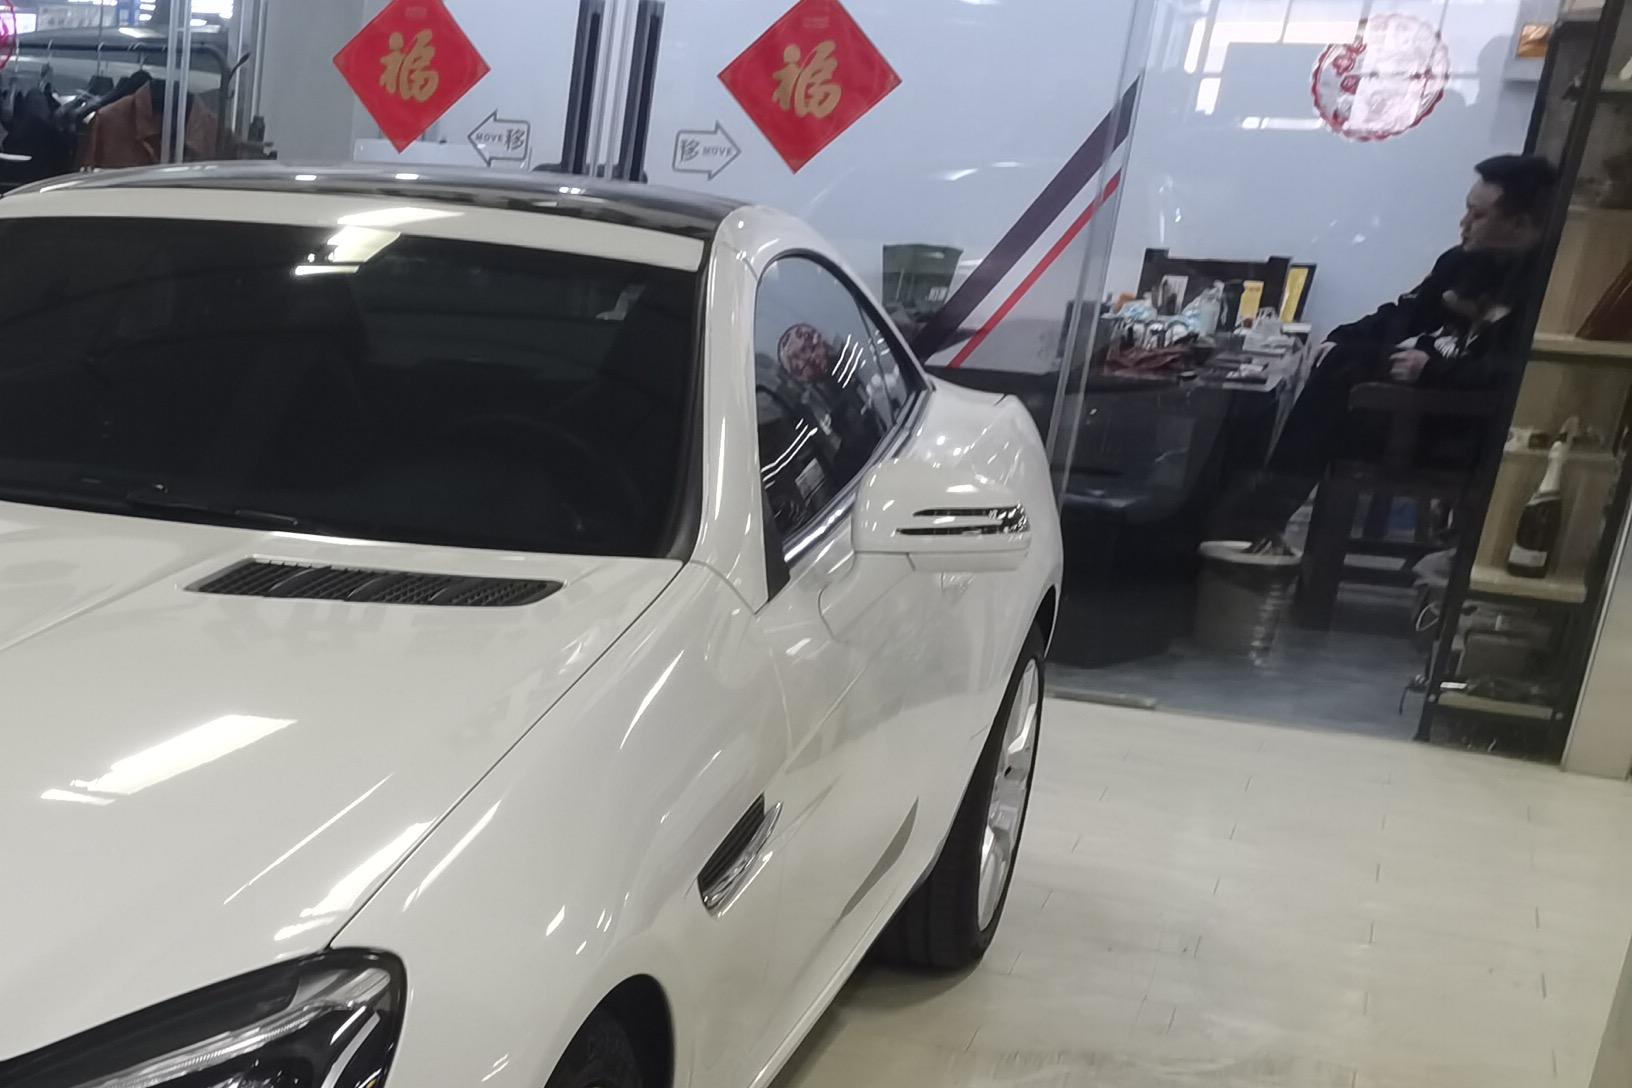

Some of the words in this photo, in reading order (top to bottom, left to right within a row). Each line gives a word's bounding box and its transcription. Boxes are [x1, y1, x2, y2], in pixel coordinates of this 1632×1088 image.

[380, 28, 439, 102] 福
[772, 40, 841, 119] 福
[475, 132, 503, 142] MOVE
[505, 129, 525, 150] 移
[680, 139, 699, 161] 移
[703, 146, 732, 156] MOVE
